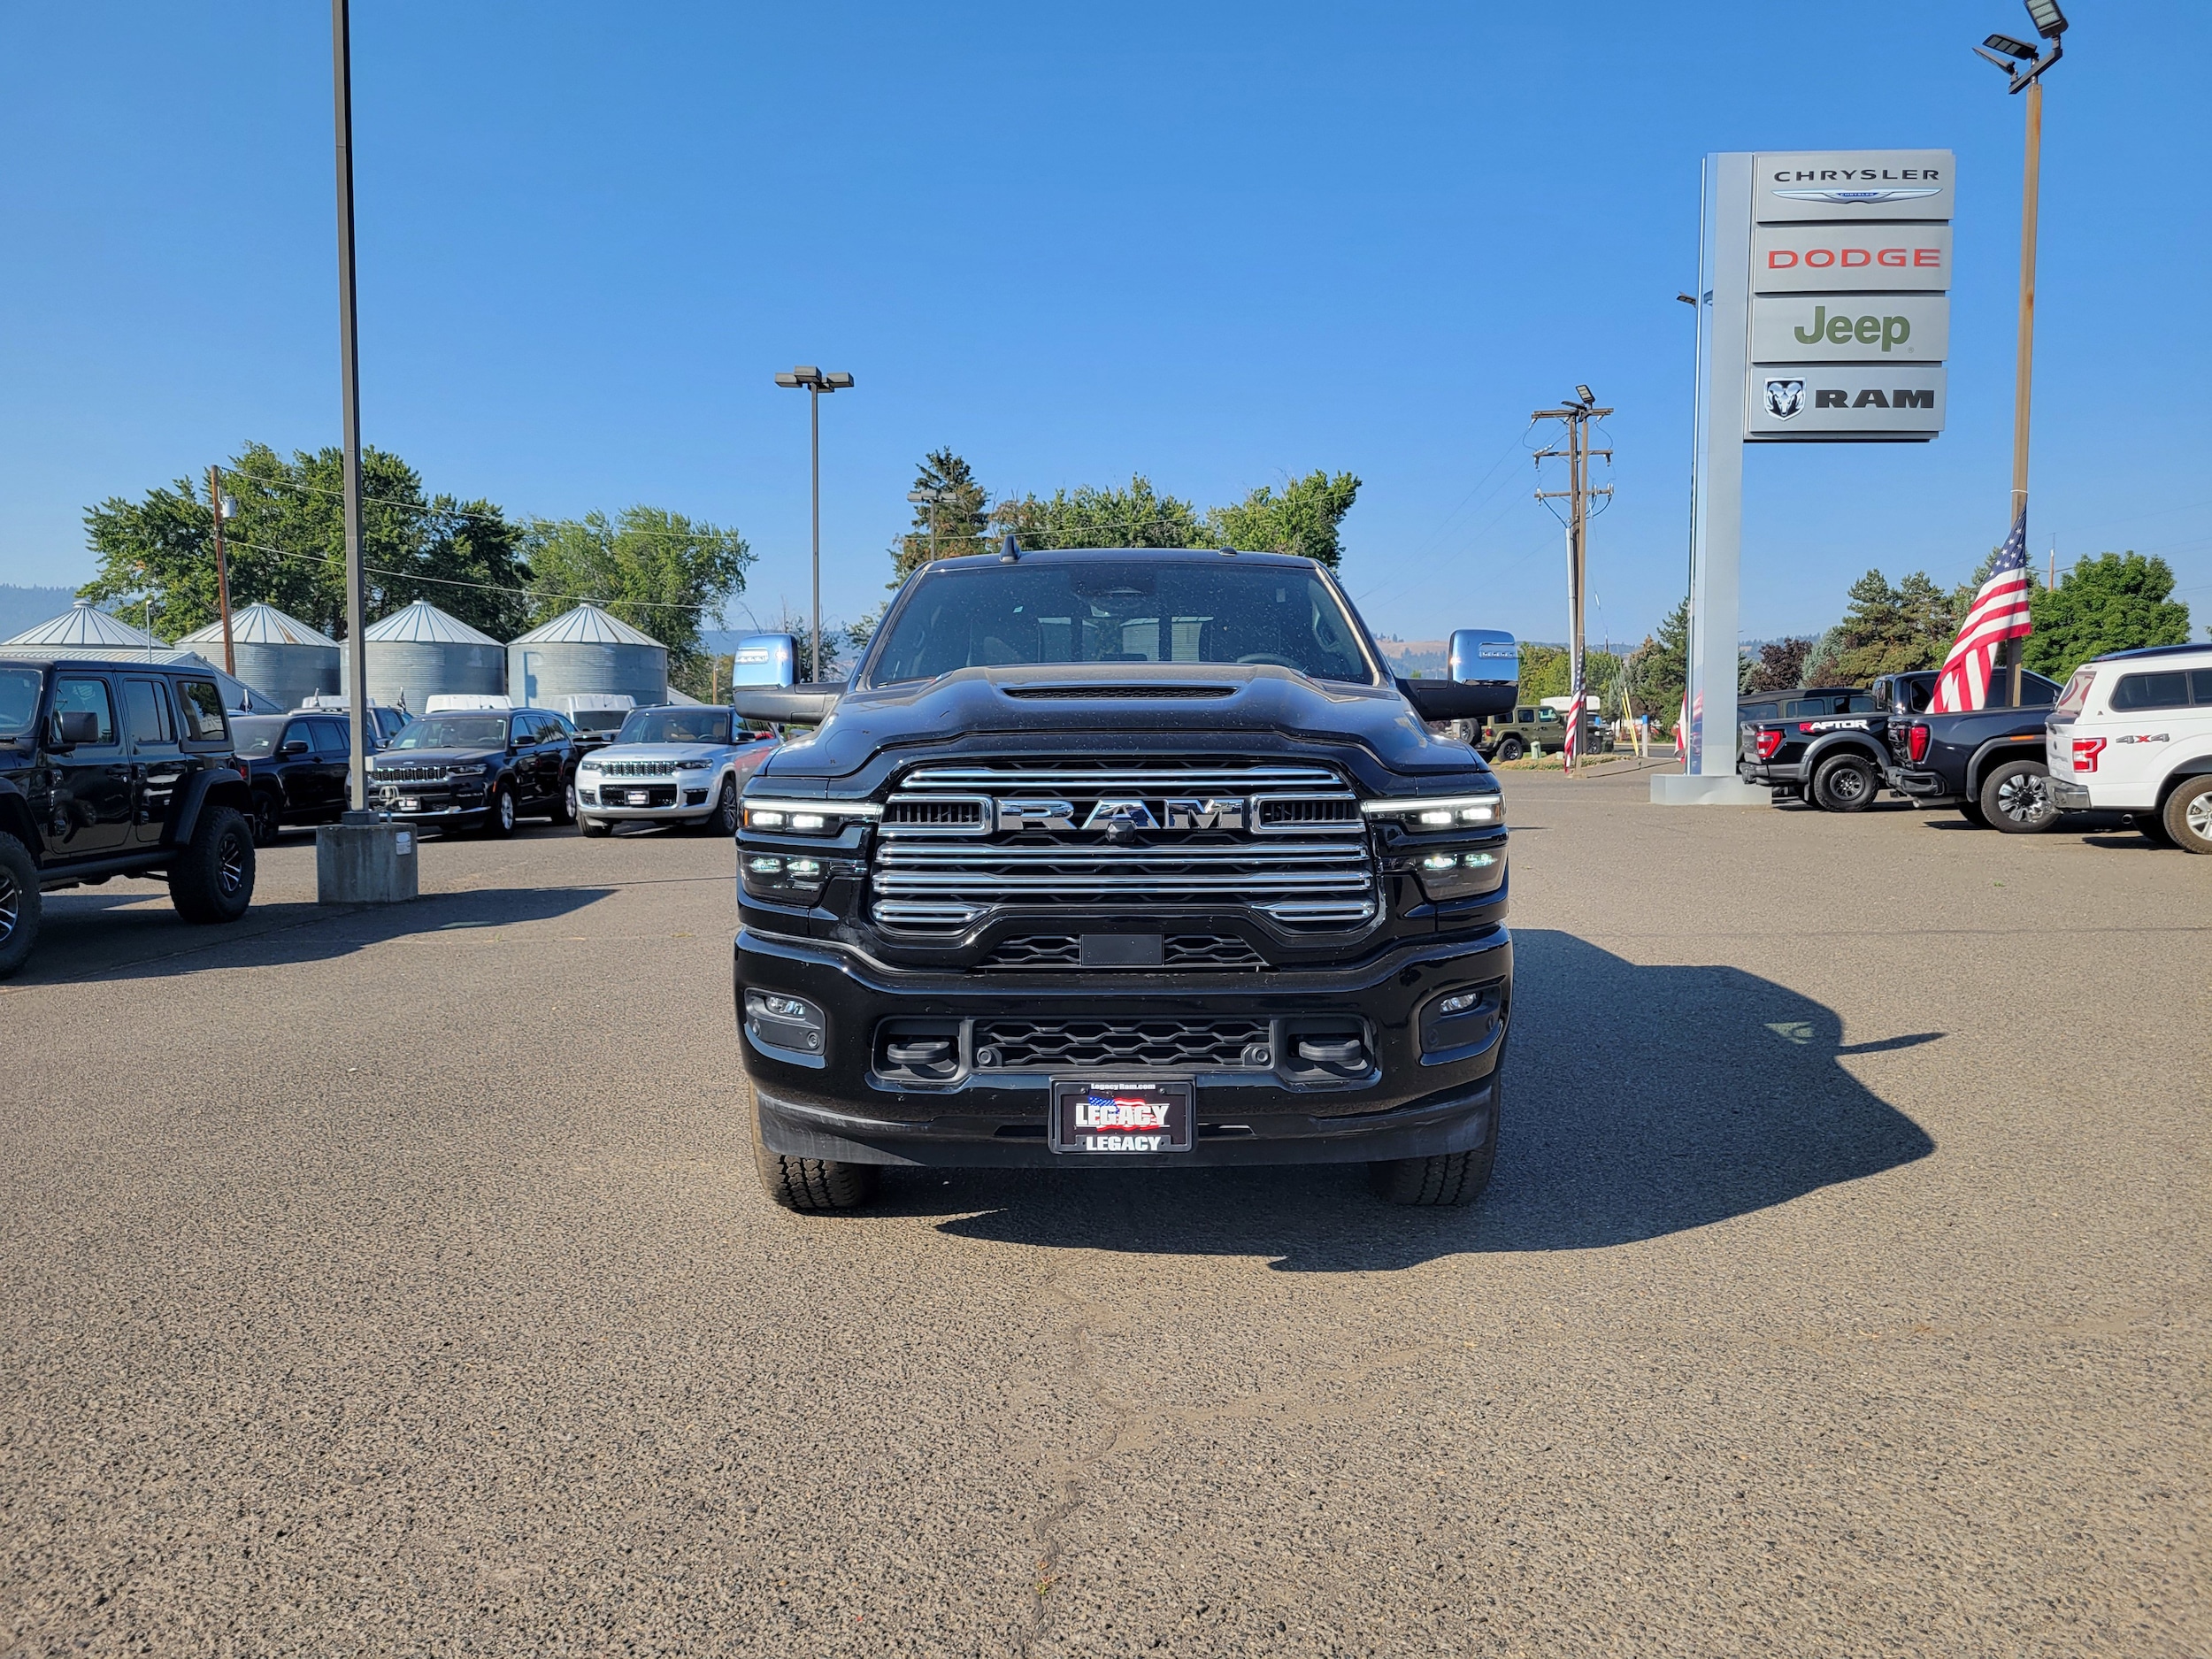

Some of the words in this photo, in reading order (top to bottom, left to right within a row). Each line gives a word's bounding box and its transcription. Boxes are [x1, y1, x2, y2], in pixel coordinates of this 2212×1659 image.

[1774, 169, 1939, 182] CHRYSLER
[1768, 249, 1941, 269] DODGE
[1793, 306, 1910, 352] Jeep
[1815, 389, 1934, 409] RAM
[1799, 719, 1870, 733] RAPTOR
[997, 798, 1245, 830] RAM
[1076, 1105, 1170, 1125] LEGACY
[1086, 1136, 1161, 1151] LEGACY
